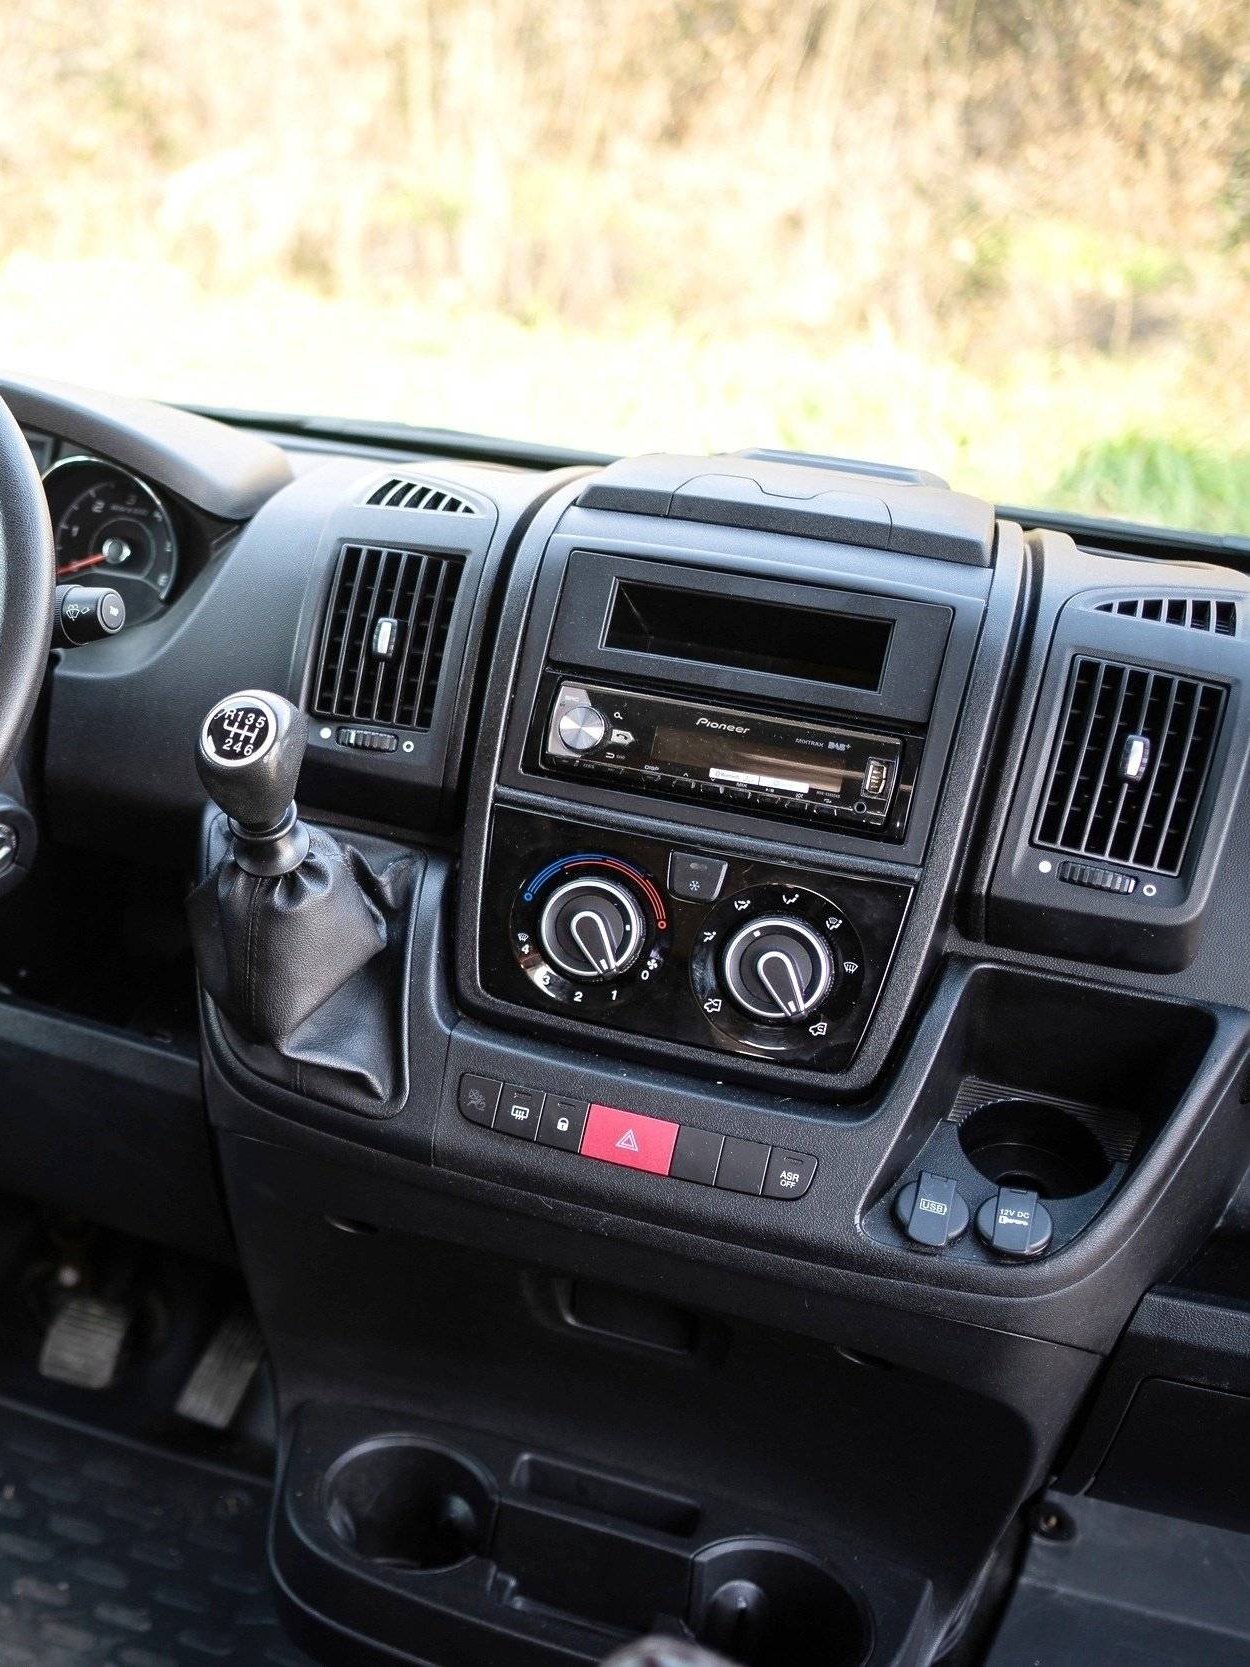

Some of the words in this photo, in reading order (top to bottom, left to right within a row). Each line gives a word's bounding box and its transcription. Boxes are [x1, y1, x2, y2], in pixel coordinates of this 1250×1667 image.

[224, 707, 237, 720] R
[237, 710, 245, 722] 1
[245, 713, 256, 725] 3
[255, 716, 267, 729] 5
[696, 717, 751, 734] Pioneer
[222, 738, 233, 751] 2
[233, 741, 243, 754] 4
[243, 744, 254, 756] 6
[521, 944, 530, 955] 4
[542, 974, 551, 986] 3
[641, 969, 650, 981] 0
[573, 991, 583, 1002] 2
[611, 989, 618, 1001] 1
[780, 1170, 800, 1183] ASR
[780, 1179, 796, 1188] OFF
[922, 1200, 943, 1213] USB
[1000, 1208, 1015, 1217] 12V
[1017, 1210, 1030, 1219] DC
